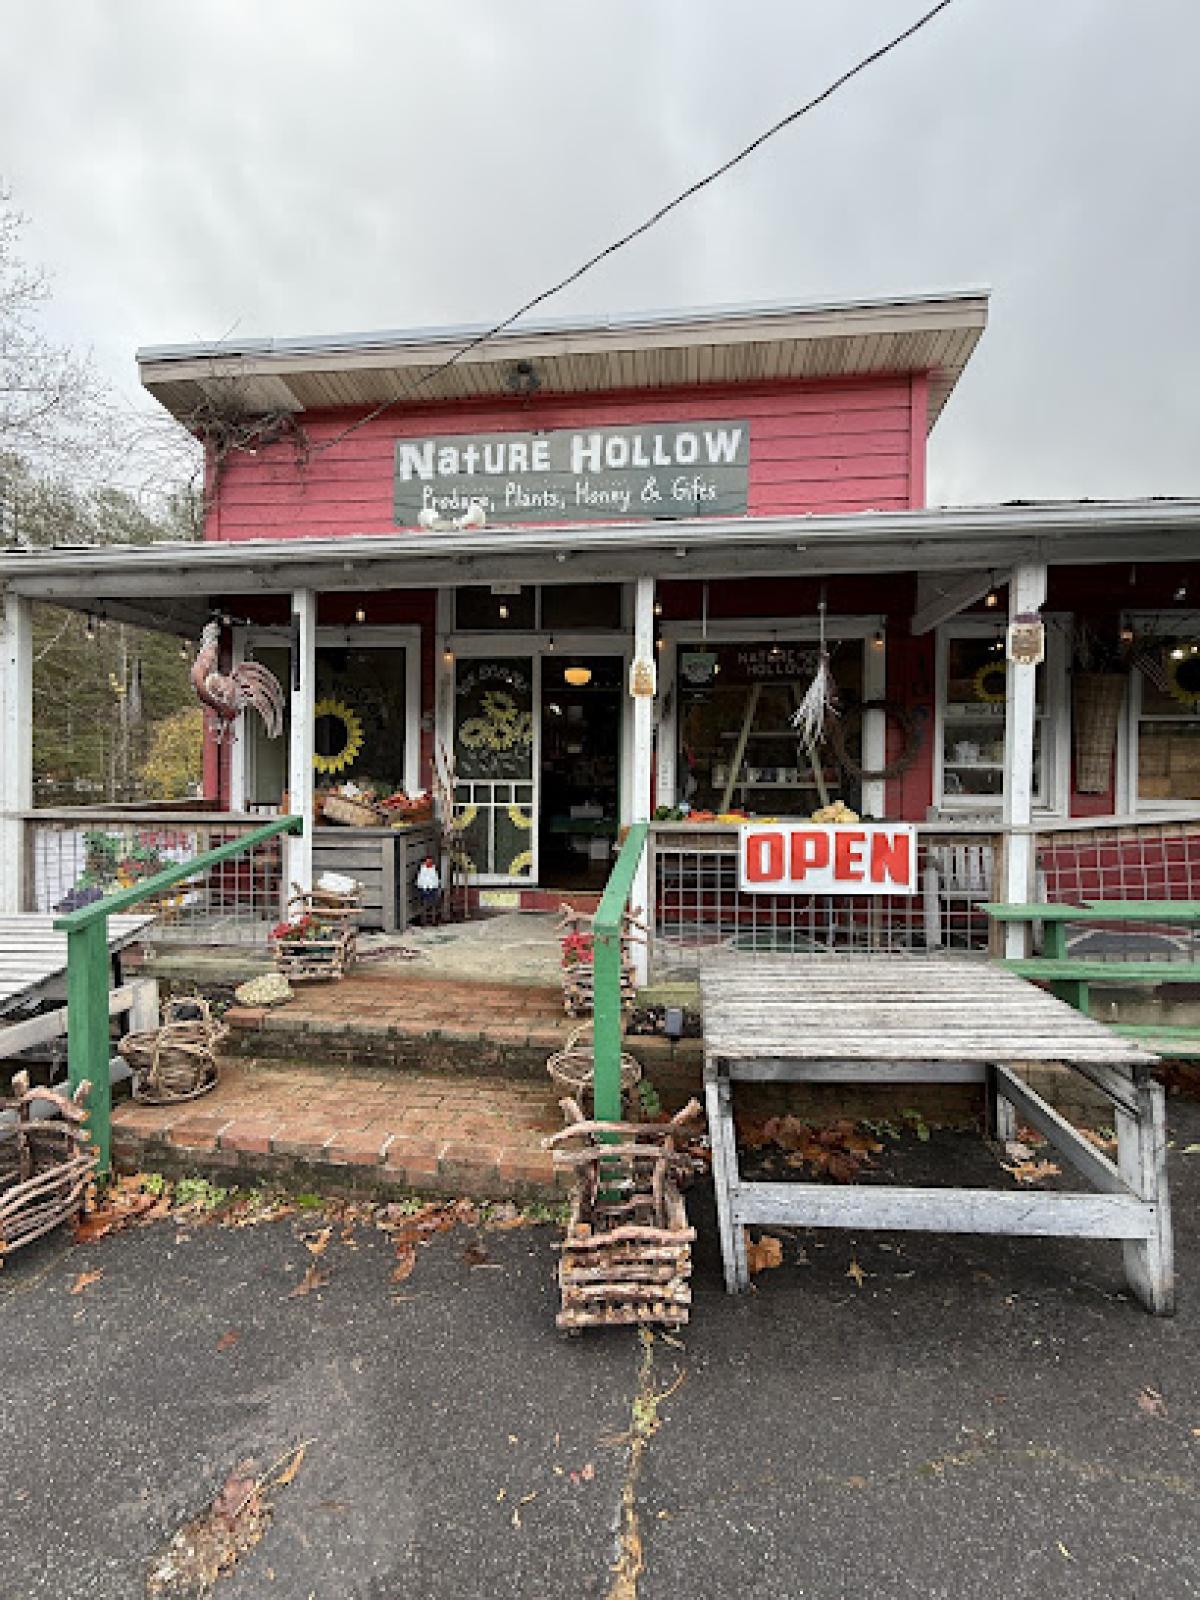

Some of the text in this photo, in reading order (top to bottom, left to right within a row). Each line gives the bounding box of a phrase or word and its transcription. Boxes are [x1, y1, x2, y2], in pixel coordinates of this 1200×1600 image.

[570, 429, 742, 474] HOLLOW
[505, 481, 566, 510] Plants,
[576, 480, 631, 512] Honey
[641, 476, 662, 502] &
[672, 474, 717, 503] Gifts
[746, 831, 910, 885] OPEN
